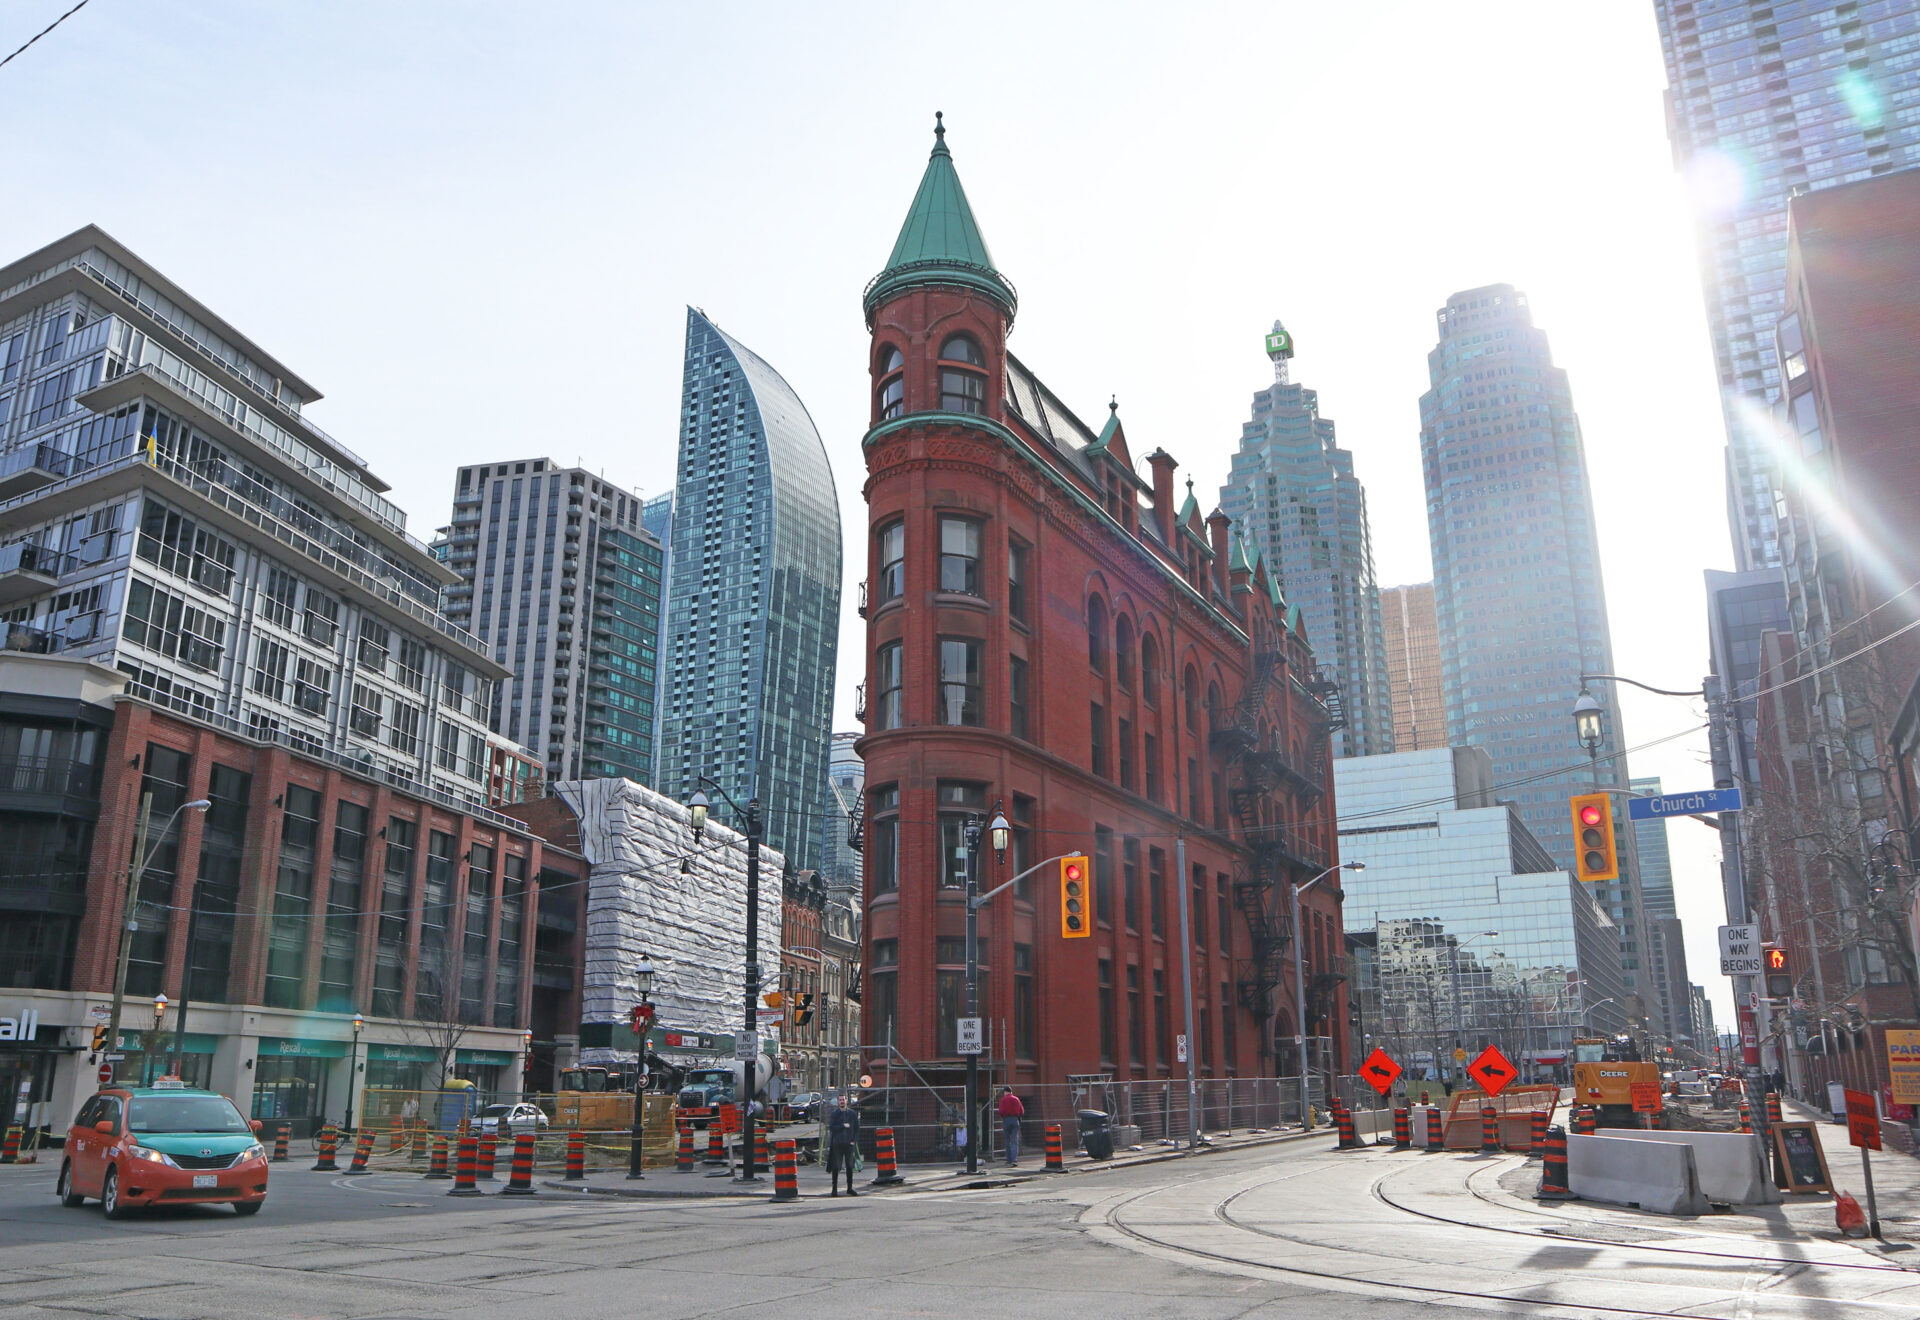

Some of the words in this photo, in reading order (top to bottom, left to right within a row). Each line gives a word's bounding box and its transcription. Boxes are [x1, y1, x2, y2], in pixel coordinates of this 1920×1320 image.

[1267, 334, 1286, 348] TD
[1650, 794, 1705, 813] Church
[1708, 792, 1717, 801] St
[1728, 929, 1749, 940] ONE
[1729, 944, 1749, 955] WAY
[1722, 959, 1760, 971] BEGINS
[963, 1021, 976, 1030] ONE
[1796, 1026, 1807, 1034] 52
[742, 1034, 751, 1042] NO
[963, 1031, 976, 1040] WAY
[280, 1041, 301, 1054] Rexall
[958, 1042, 981, 1051] BEGINS
